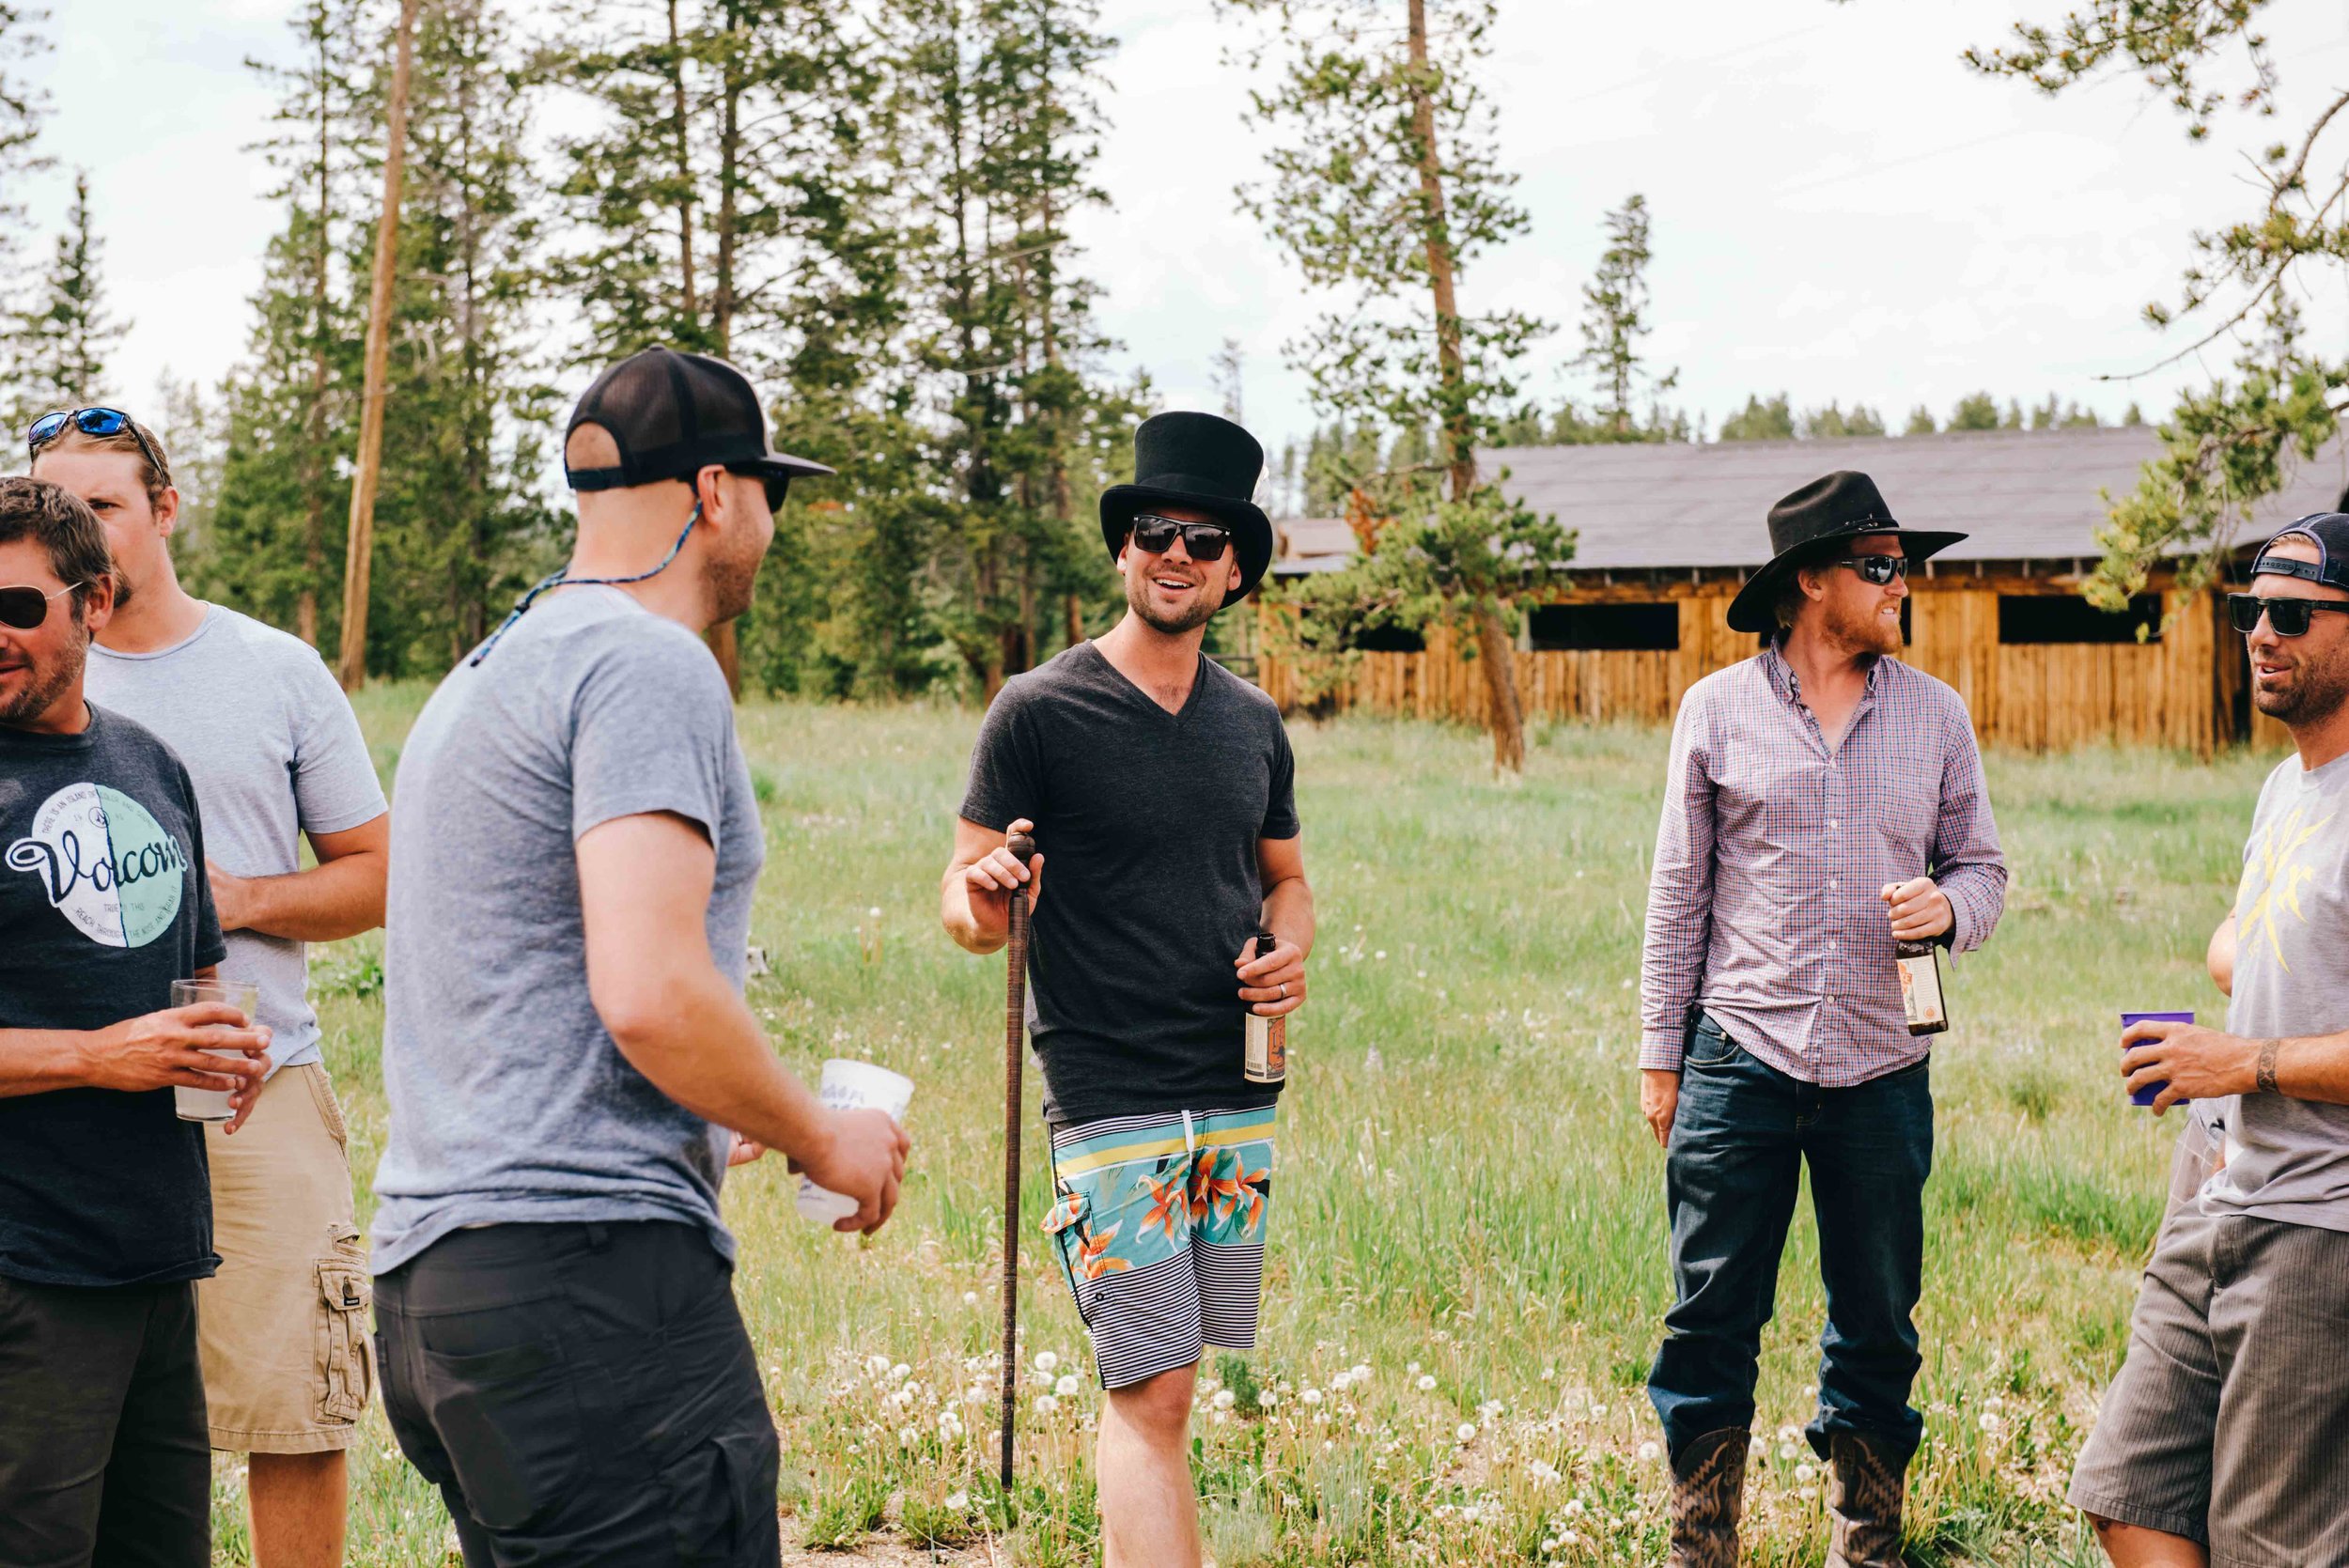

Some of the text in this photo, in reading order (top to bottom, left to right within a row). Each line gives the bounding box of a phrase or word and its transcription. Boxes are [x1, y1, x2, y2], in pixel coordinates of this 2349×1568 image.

[57, 800, 68, 809] AN
[8, 829, 187, 904] Volcom
[103, 903, 119, 912] TRUE
[131, 902, 145, 911] THIS
[75, 907, 95, 927] REACH
[129, 929, 140, 939] THE
